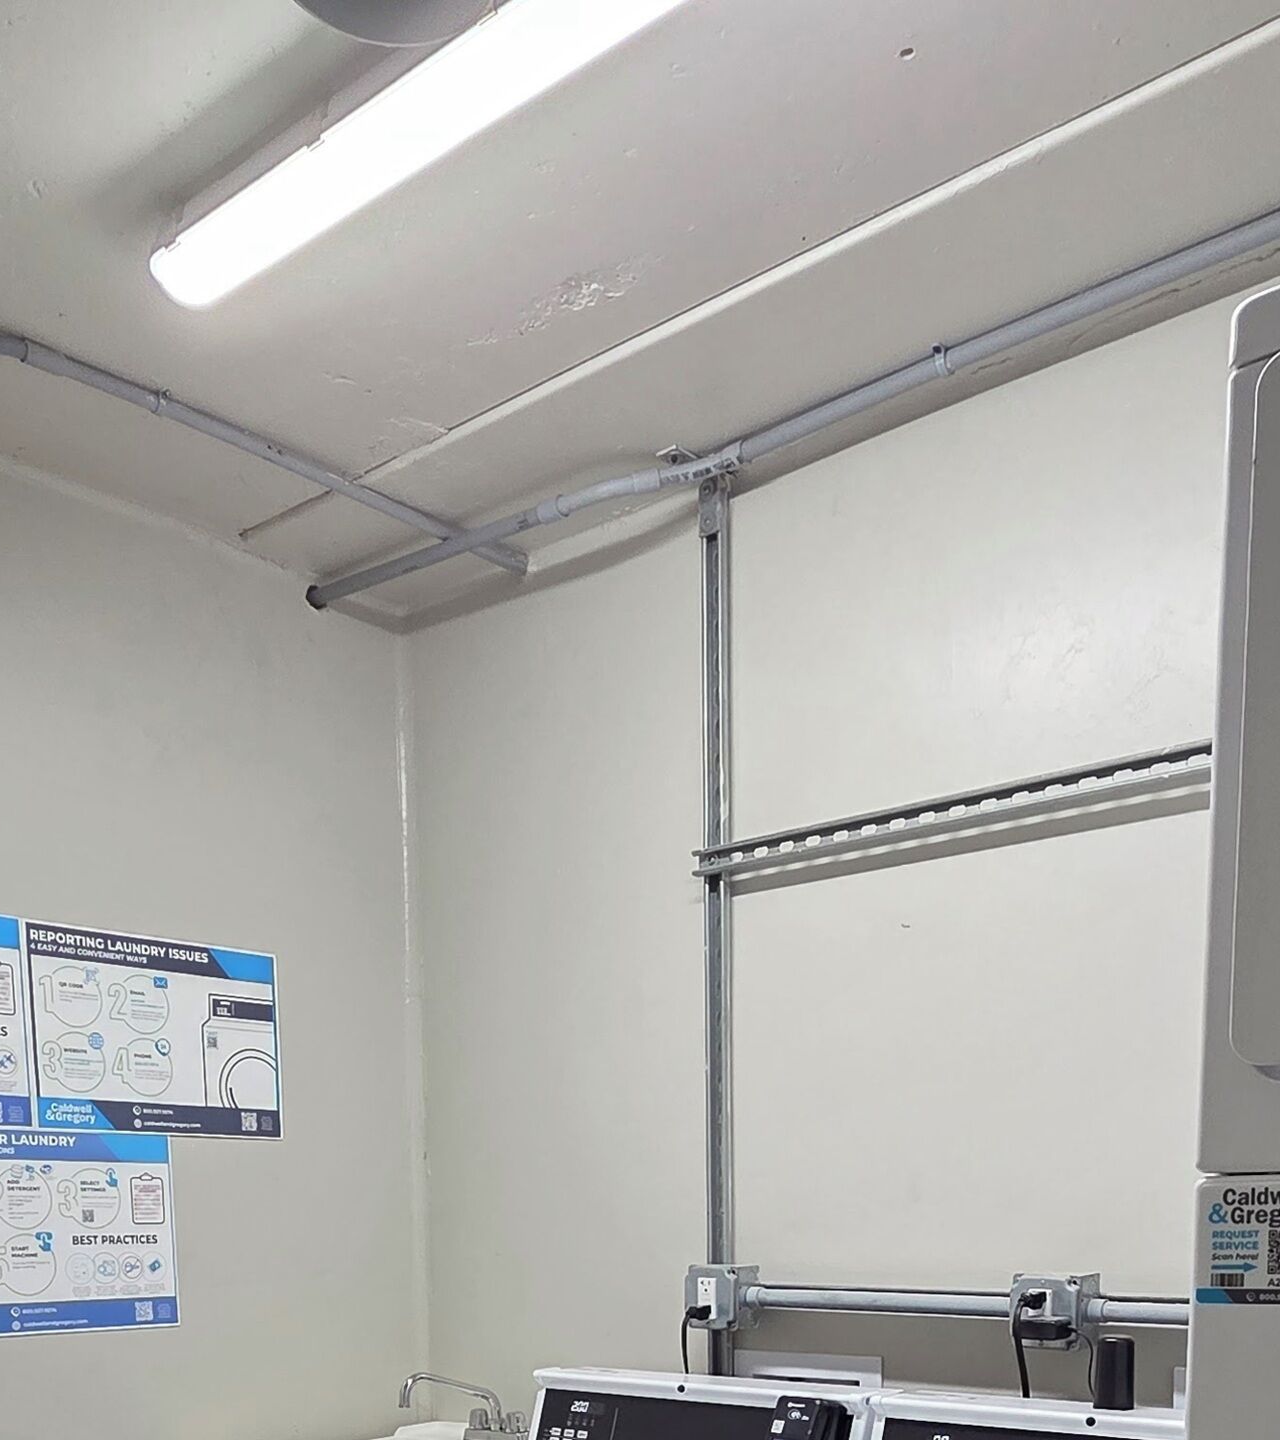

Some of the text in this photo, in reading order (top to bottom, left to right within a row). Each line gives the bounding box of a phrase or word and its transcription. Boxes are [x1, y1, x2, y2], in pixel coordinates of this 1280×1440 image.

[29, 929, 209, 963] REPORTING LAUNDRY ISSUES
[37, 943, 58, 952] EASY
[58, 946, 76, 954] AND
[77, 948, 124, 960] CONVENIENT
[126, 954, 147, 964] WAYS
[50, 1102, 93, 1114] Caldwell
[11, 1134, 76, 1147] LAUNDRY
[72, 1234, 158, 1245] BEST PRACTICES
[1212, 1230, 1259, 1240] REQUEST
[1212, 1241, 1259, 1250] SERVICE
[1211, 1253, 1233, 1261] Scan
